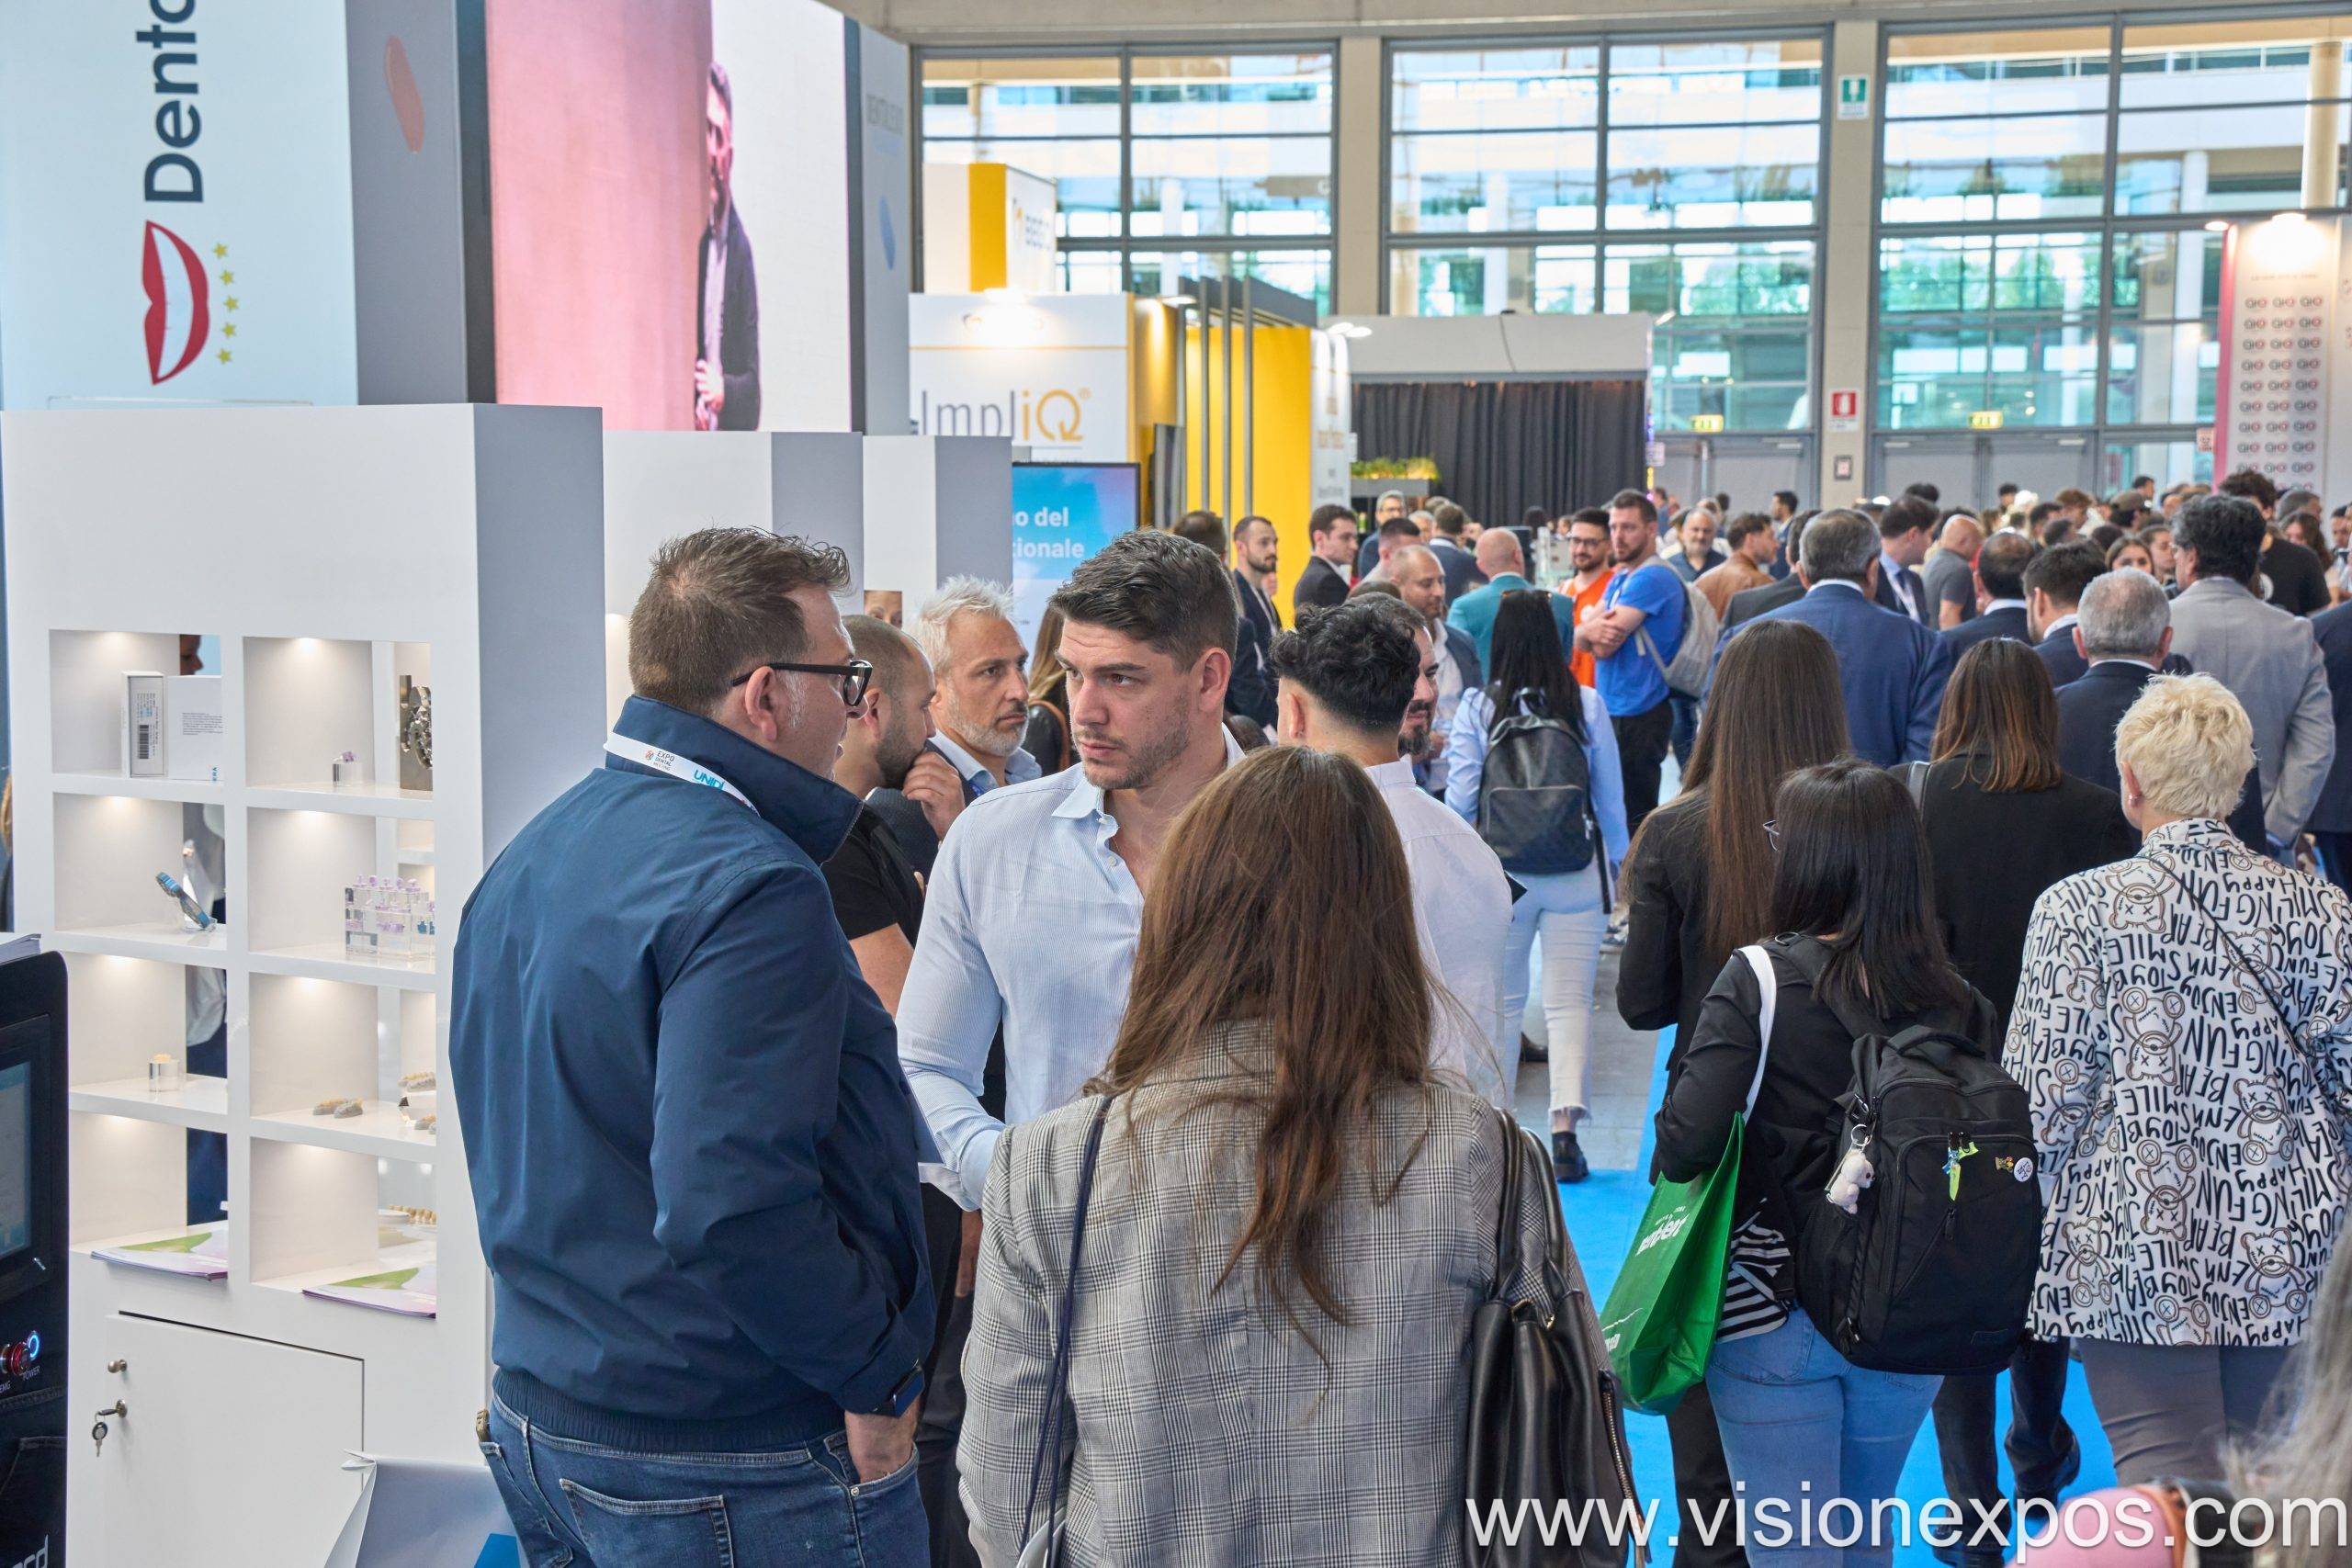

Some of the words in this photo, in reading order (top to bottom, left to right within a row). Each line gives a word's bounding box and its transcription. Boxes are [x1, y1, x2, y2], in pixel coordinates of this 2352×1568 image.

[1035, 506, 1069, 527] del
[655, 757, 673, 767] DENTAL
[657, 750, 675, 761] EXPO
[2183, 1016, 2239, 1069] FUN
[2195, 1168, 2246, 1223] FUN
[23, 1365, 40, 1382] POWER
